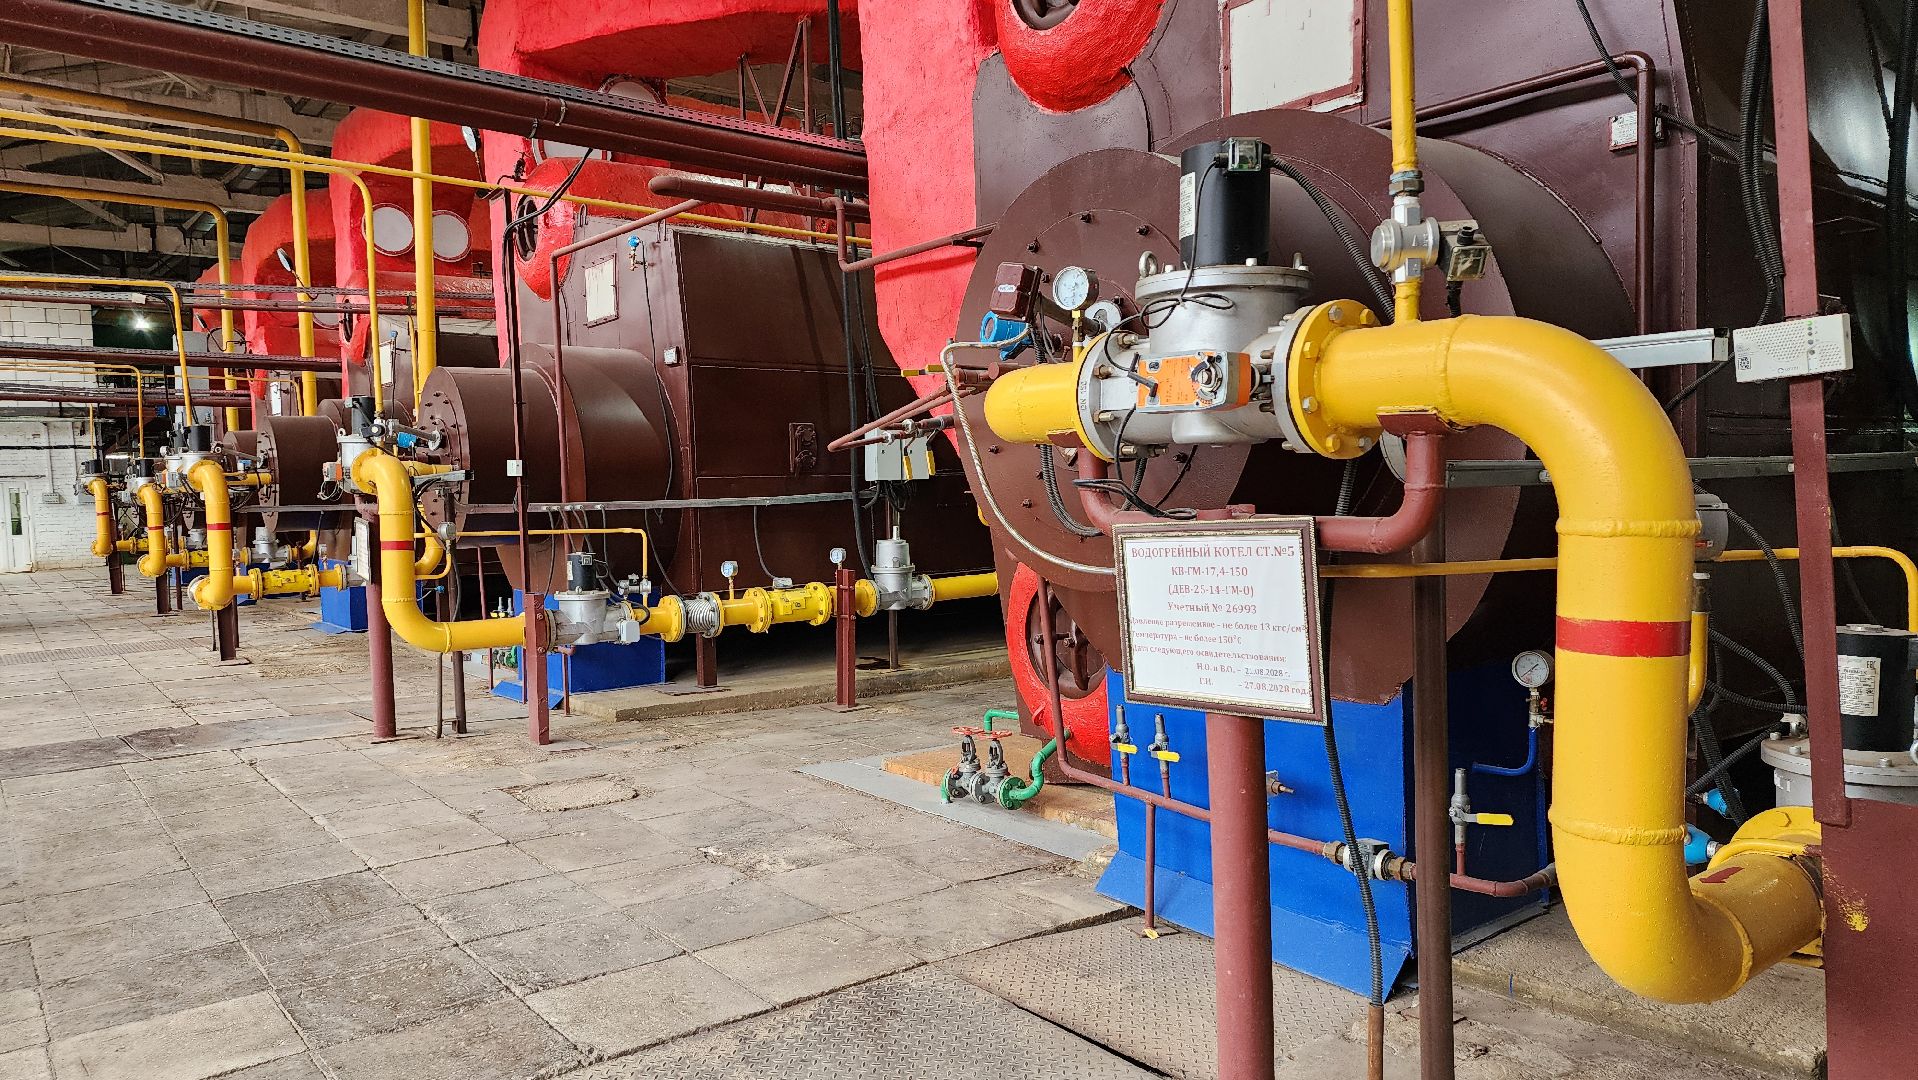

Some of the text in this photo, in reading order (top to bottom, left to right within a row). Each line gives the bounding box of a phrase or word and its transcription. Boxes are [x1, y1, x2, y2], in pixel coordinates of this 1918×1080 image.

[1131, 544, 1211, 559] ВОДОГРЕЙНЫЙ
[1214, 546, 1252, 558] КОТЕЛ
[1171, 566, 1248, 577] КВ-ГМ-17,4-150
[1167, 601, 1210, 613] Учетный
[1225, 603, 1257, 614] 26993
[1234, 621, 1258, 631] более
[1260, 622, 1271, 631] 13
[1193, 634, 1217, 643] более
[1149, 646, 1194, 656] следующего
